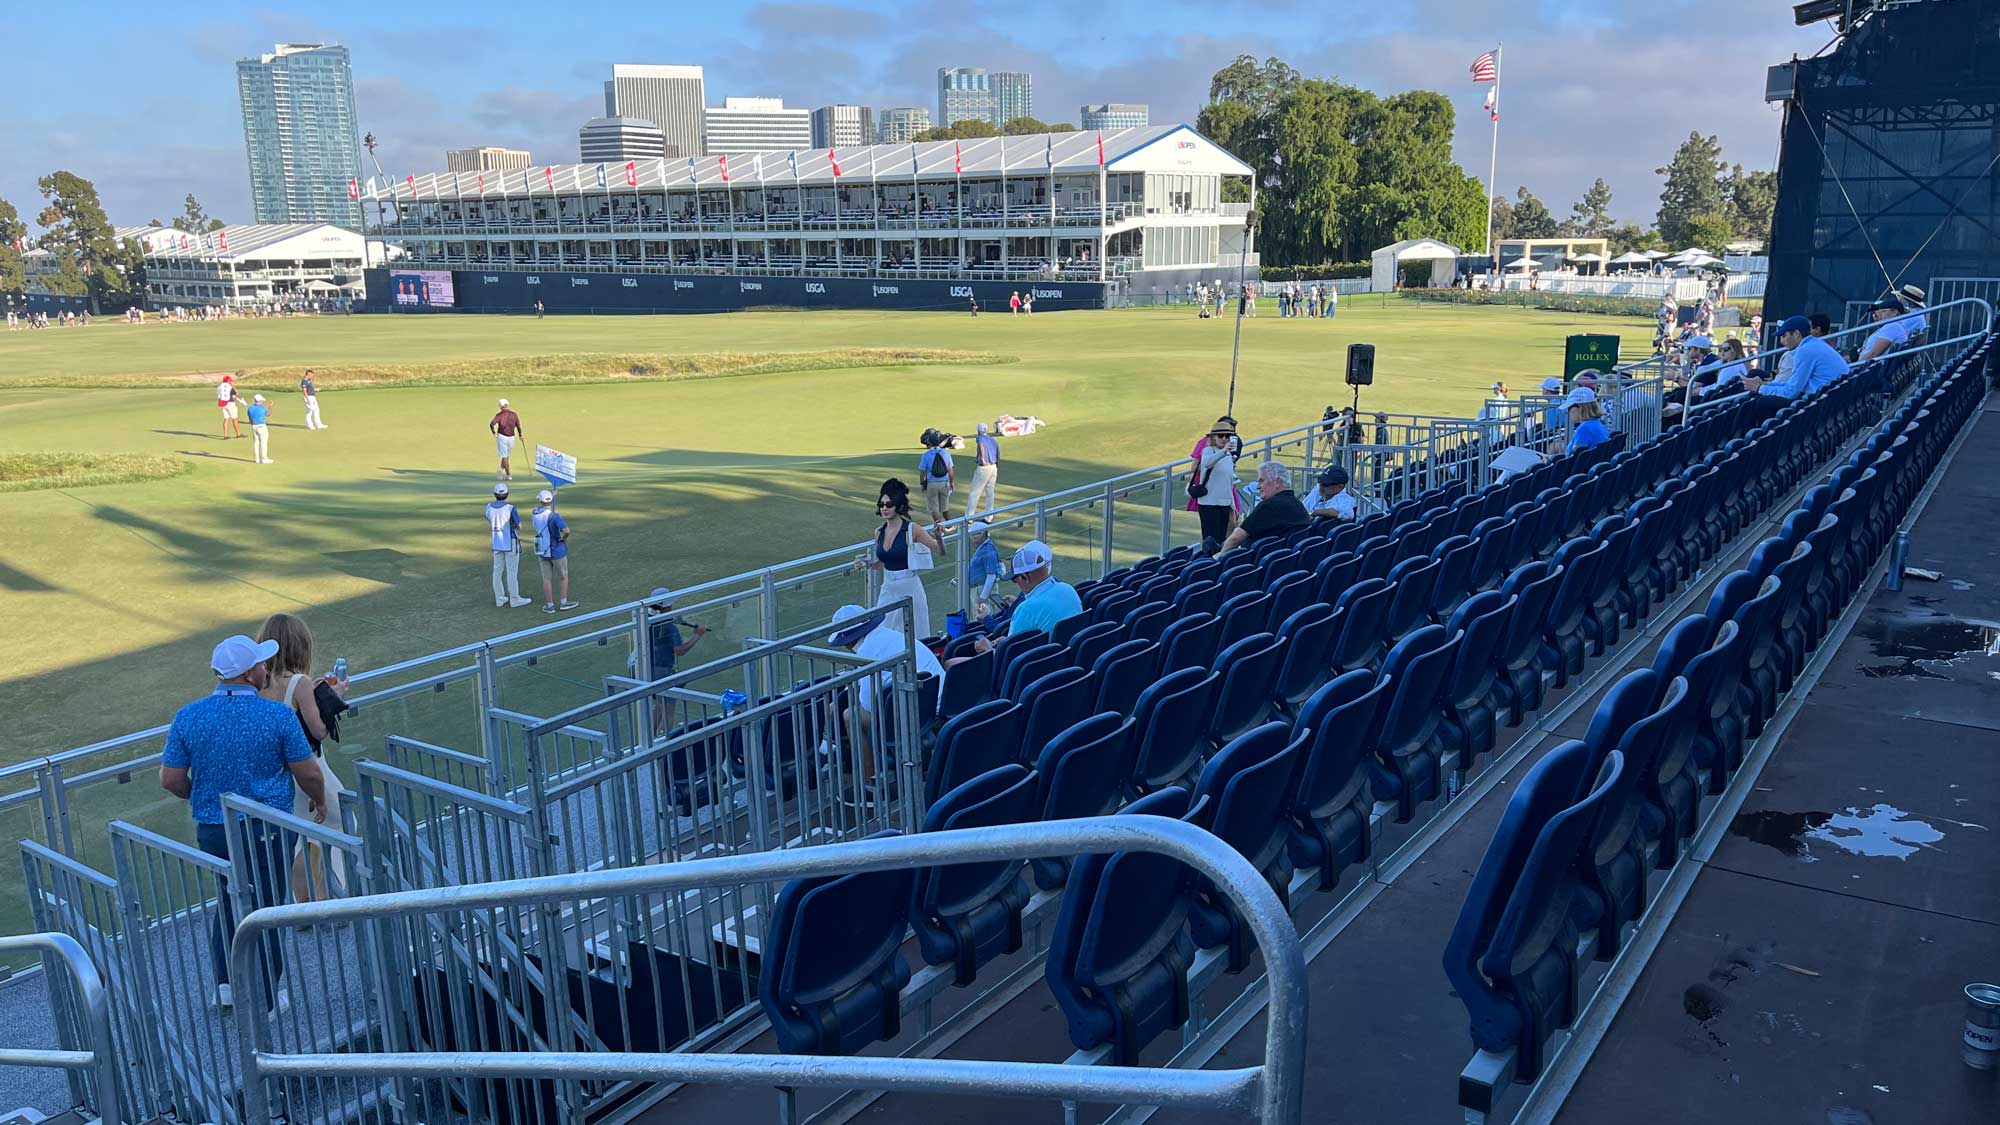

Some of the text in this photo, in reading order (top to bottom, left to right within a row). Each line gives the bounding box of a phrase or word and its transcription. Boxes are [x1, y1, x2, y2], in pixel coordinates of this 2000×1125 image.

[622, 278, 638, 287] USGA
[805, 282, 825, 293] USGA
[950, 286, 973, 297] USGA
[1575, 353, 1610, 361] ROLEX
